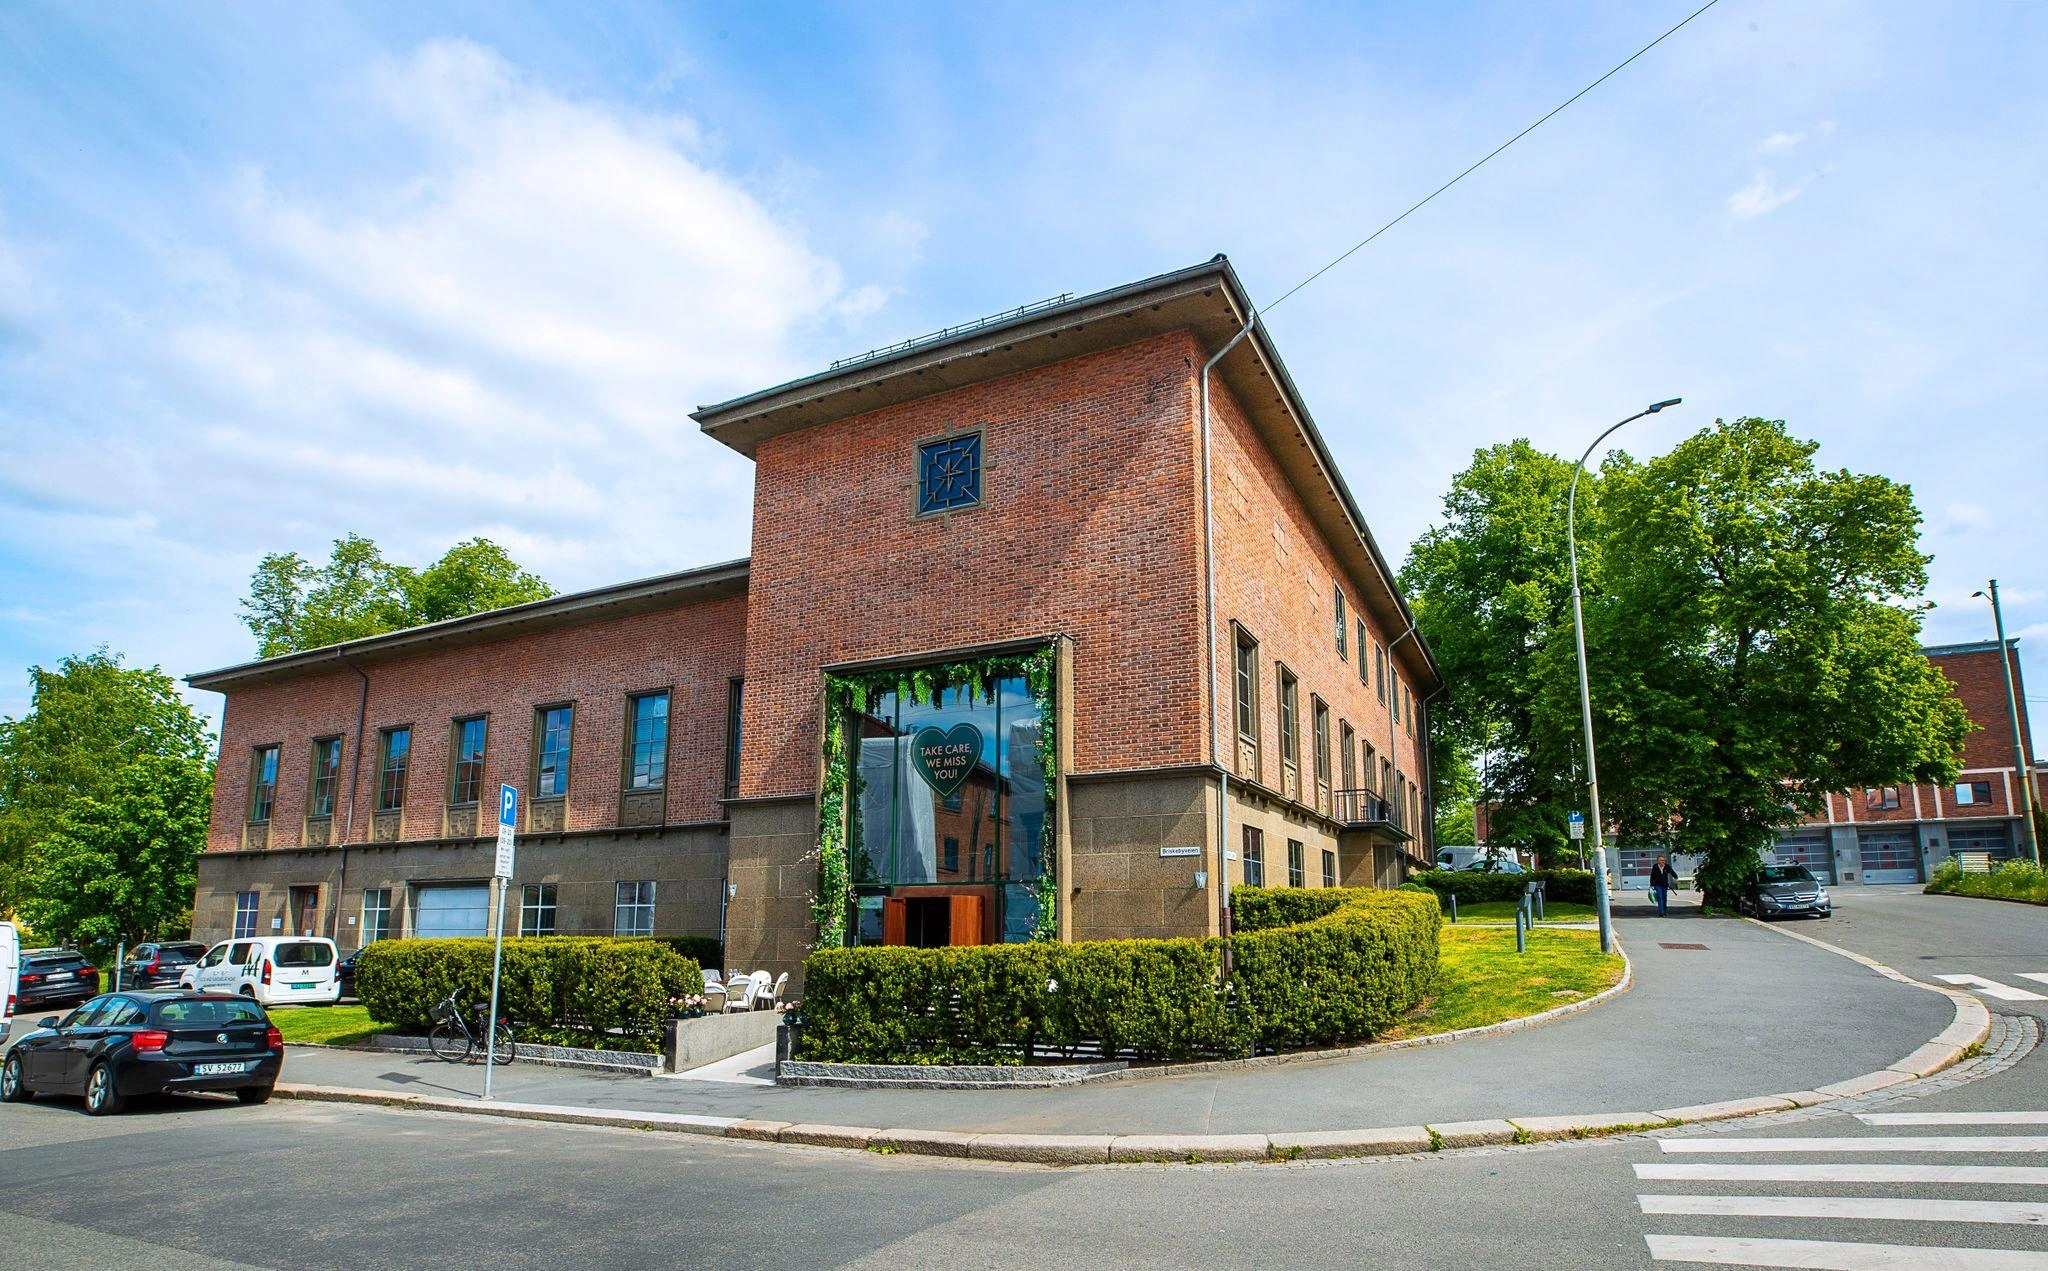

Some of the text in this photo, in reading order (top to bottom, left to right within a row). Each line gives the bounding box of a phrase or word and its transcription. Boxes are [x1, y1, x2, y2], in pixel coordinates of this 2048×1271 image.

[921, 743, 972, 757] TAKE CARE,
[926, 756, 966, 768] WE MISS
[934, 768, 958, 779] YOU!
[504, 791, 513, 819] P
[202, 1063, 242, 1072] SV 52677
